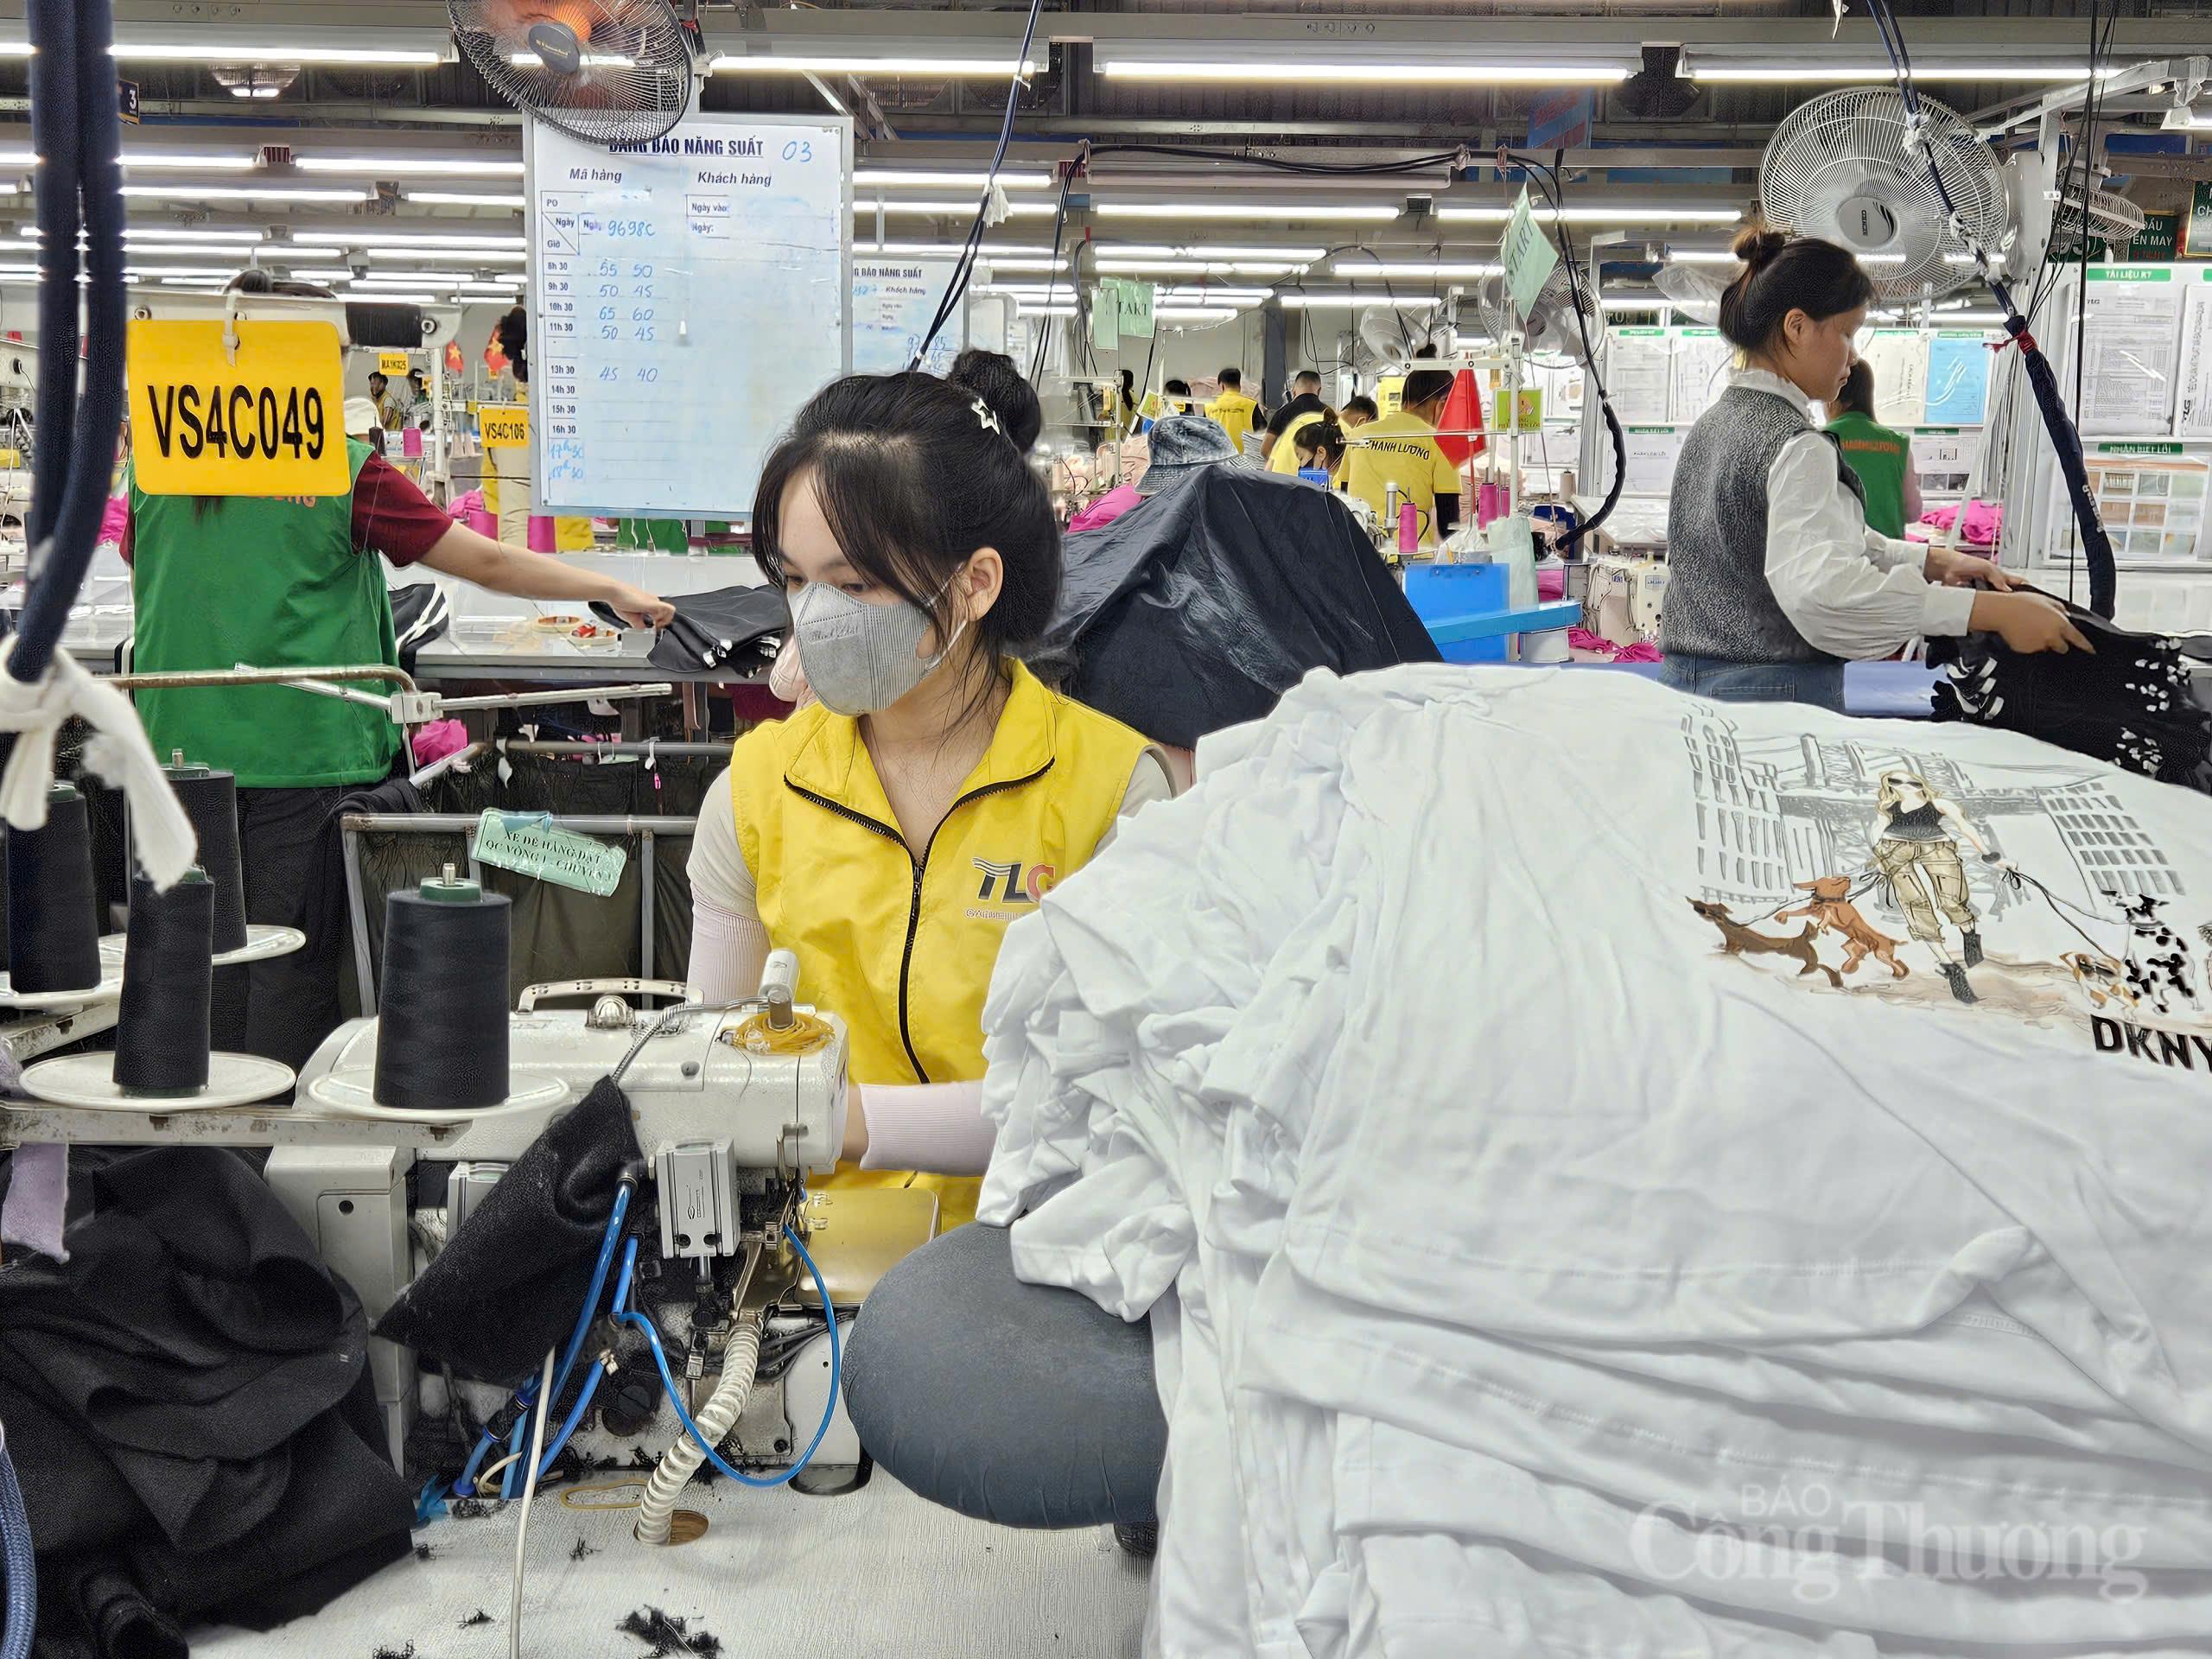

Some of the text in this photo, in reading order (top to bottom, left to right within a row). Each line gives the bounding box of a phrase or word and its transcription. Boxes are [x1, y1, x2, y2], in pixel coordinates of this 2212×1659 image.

[130, 89, 137, 110] 3
[652, 135, 679, 154] BÁO
[684, 137, 723, 156] NĂNG
[728, 135, 764, 156] SUẤT
[782, 141, 813, 162] 03
[569, 168, 622, 184] Mã hàng
[697, 171, 772, 188] Khách hàng
[556, 217, 575, 228] Ngày
[548, 262, 568, 270] 8h 30
[632, 264, 653, 278] 50
[548, 282, 569, 291] 9h 30
[600, 284, 619, 297] 50
[550, 302, 573, 312] 10h 30
[599, 306, 654, 321] 65 60
[550, 322, 574, 332] 11h 30
[601, 325, 618, 340] 50
[550, 365, 575, 374] 13h 30
[637, 367, 658, 382] 40
[551, 385, 575, 394] 14h 30
[552, 405, 576, 414] 15h 30
[147, 385, 324, 460] VS4C049
[485, 423, 525, 440] VS4C106
[552, 425, 576, 434] 16h 30
[486, 839, 504, 850] QC
